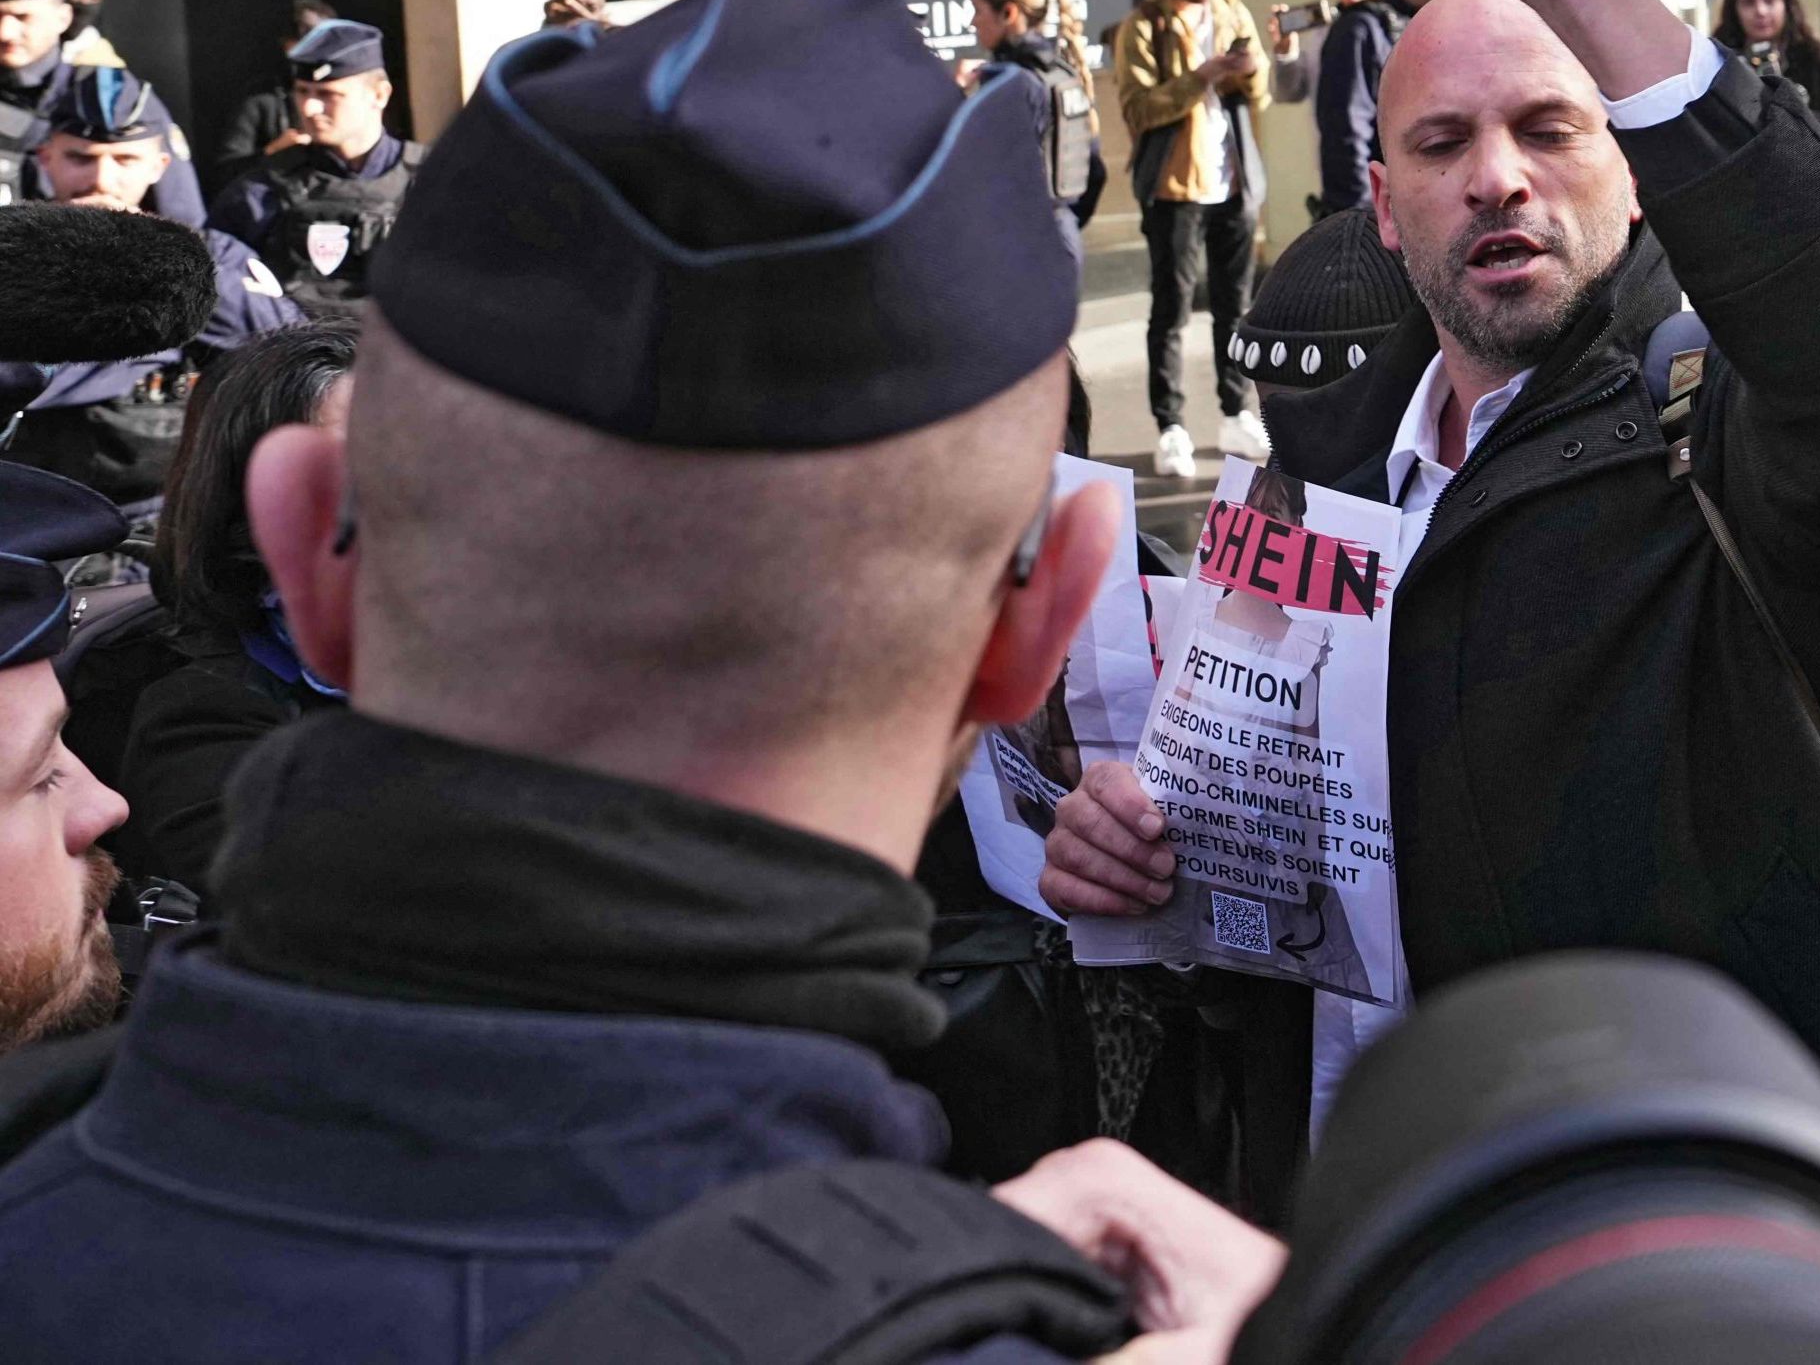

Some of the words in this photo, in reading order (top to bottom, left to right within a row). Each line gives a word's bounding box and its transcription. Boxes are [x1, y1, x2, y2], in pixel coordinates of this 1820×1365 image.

[1200, 500, 1380, 622] SHEIN
[1184, 645, 1302, 711] PETITION
[1151, 728, 1204, 766] IMMÉDIAT
[1208, 753, 1248, 777] DES
[1254, 763, 1353, 799] POUPÉES
[1160, 699, 1223, 740] EXIGEONS
[1228, 726, 1251, 748] LE
[1257, 734, 1345, 769] RETRAIT
[1243, 819, 1306, 847] SHEIN
[1318, 834, 1344, 852] ET
[1174, 854, 1299, 895] POURSUIVIS
[1283, 854, 1361, 884] SOIENT
